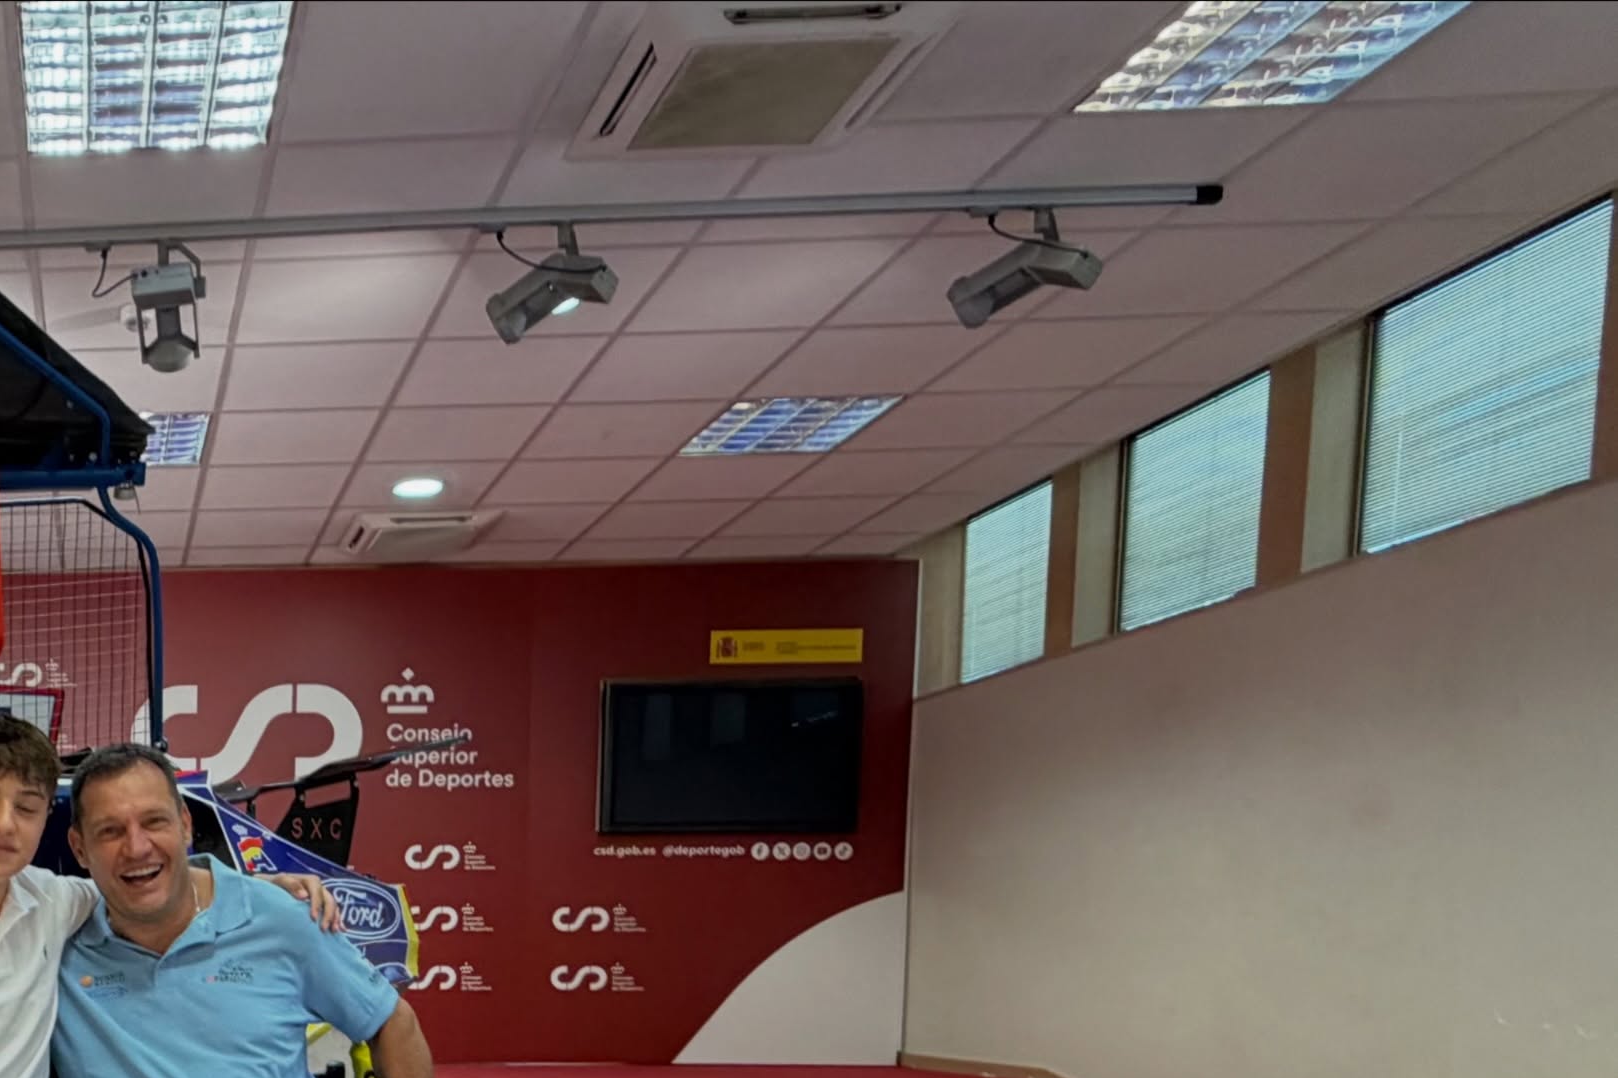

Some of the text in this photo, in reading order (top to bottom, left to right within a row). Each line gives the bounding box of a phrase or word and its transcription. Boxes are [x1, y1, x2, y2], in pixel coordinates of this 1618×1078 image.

[386, 723, 473, 743] Consejo
[386, 768, 515, 792] de Deportes
[333, 887, 385, 928] Ford
